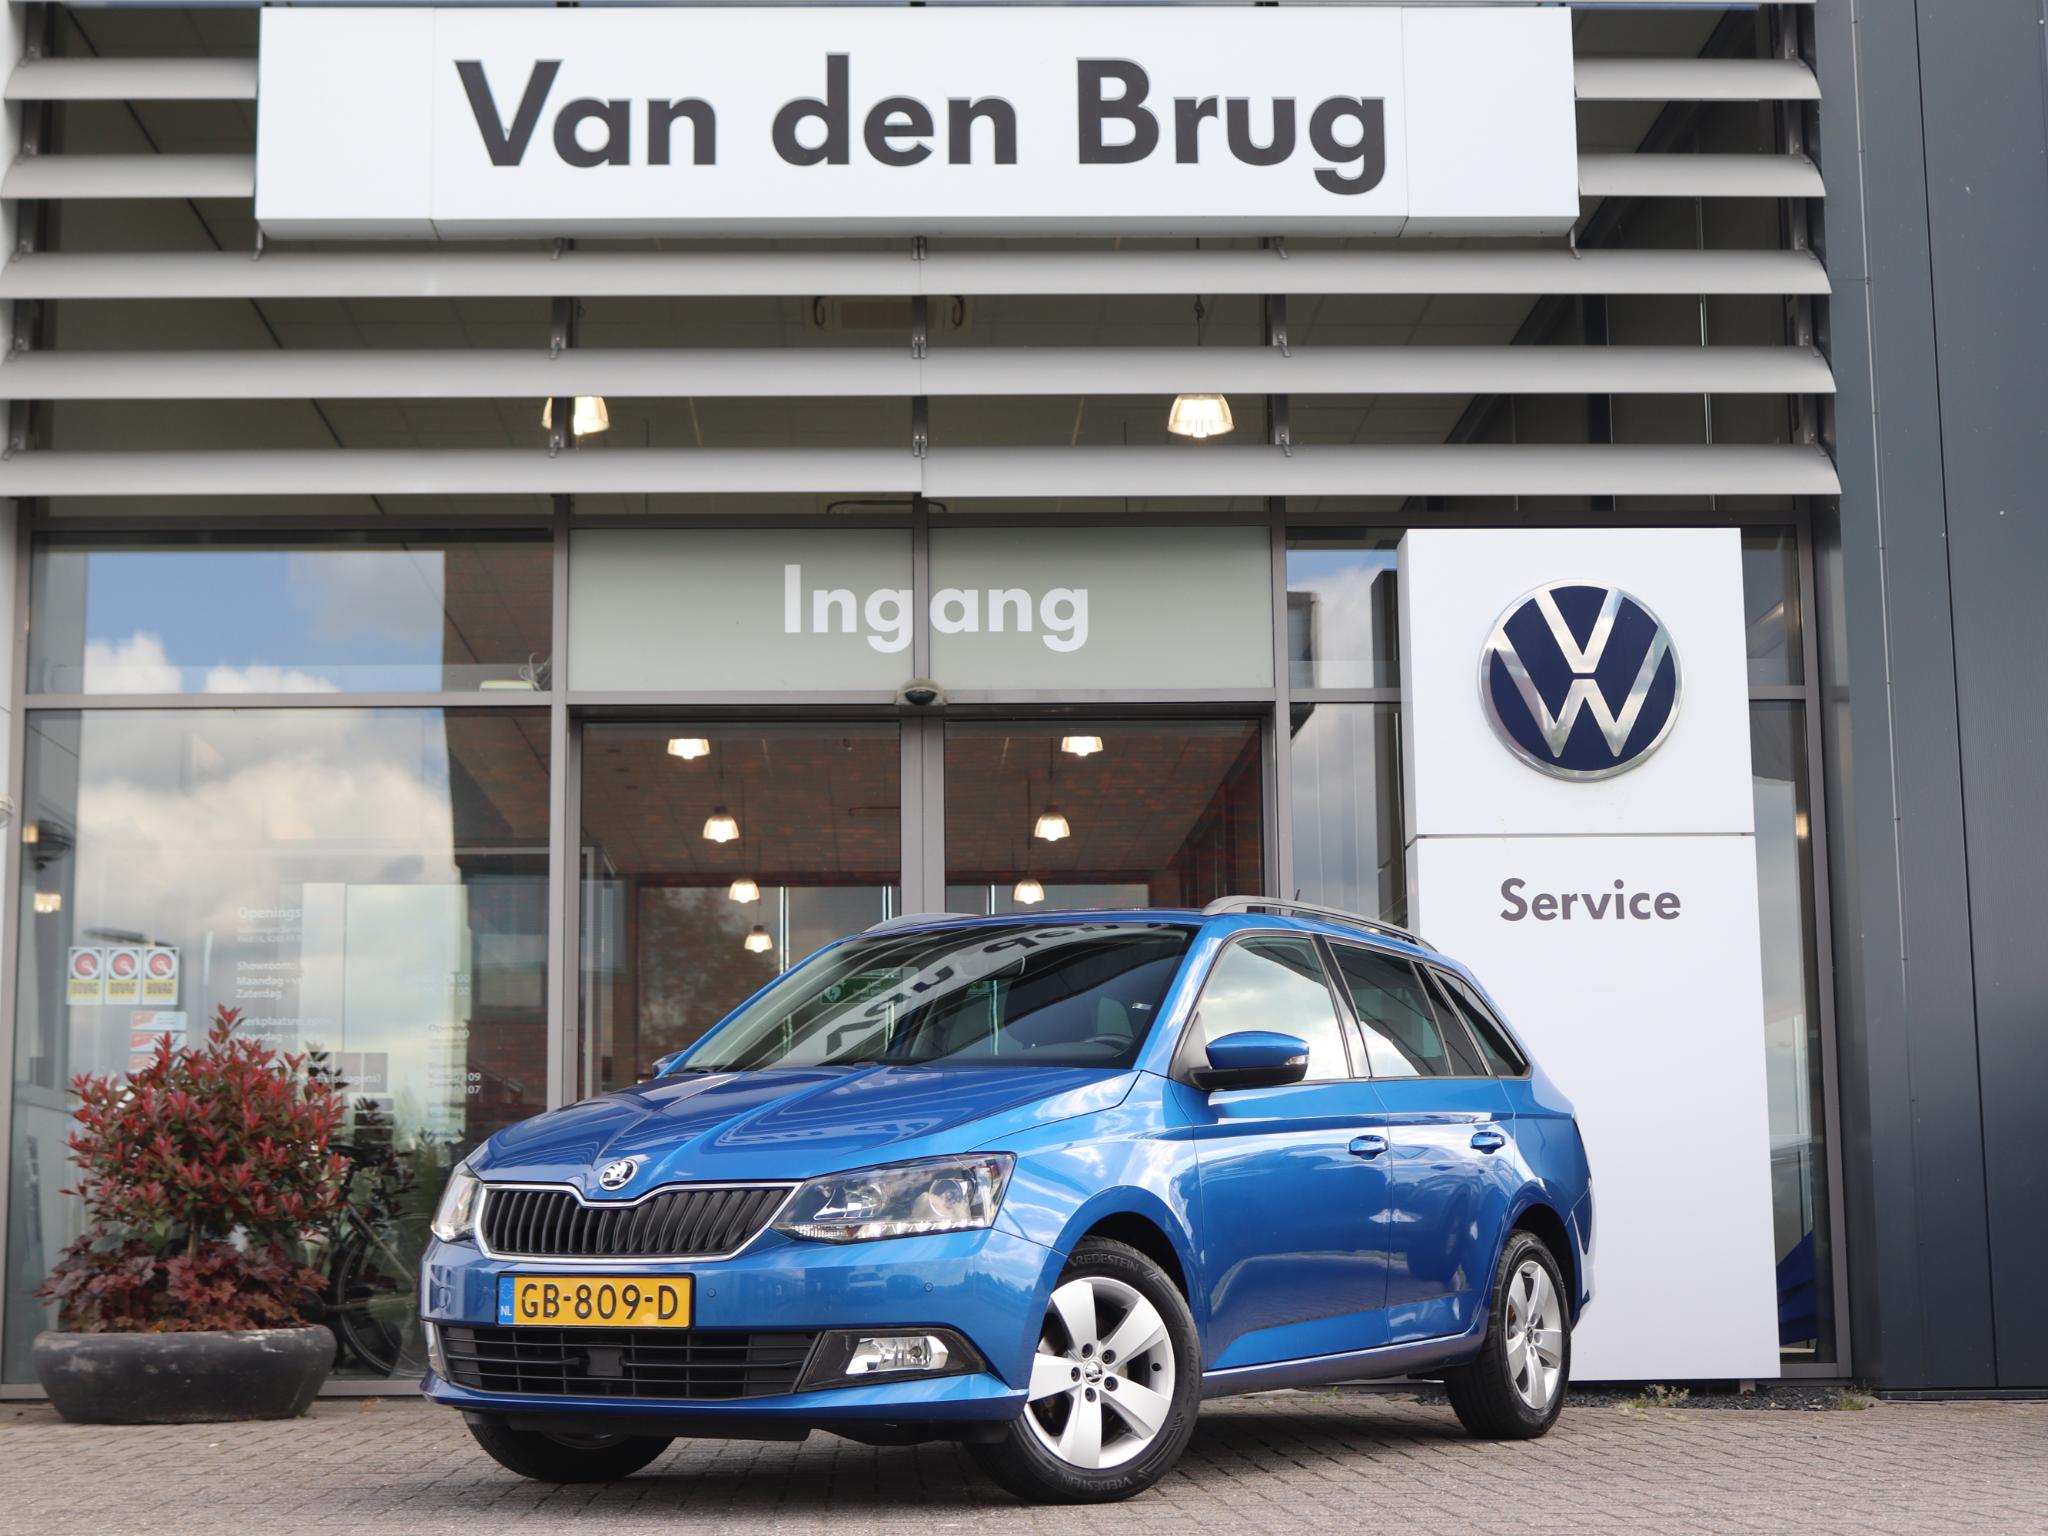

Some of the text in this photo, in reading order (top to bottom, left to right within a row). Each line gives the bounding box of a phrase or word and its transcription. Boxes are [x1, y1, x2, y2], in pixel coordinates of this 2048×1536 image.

[455, 51, 1388, 197] Van den Brug
[783, 564, 1090, 653] Ingang
[1499, 877, 1681, 921] Service
[1068, 1253, 1139, 1273] VREDESTEIN
[500, 1282, 679, 1320] NL GB-809-D
